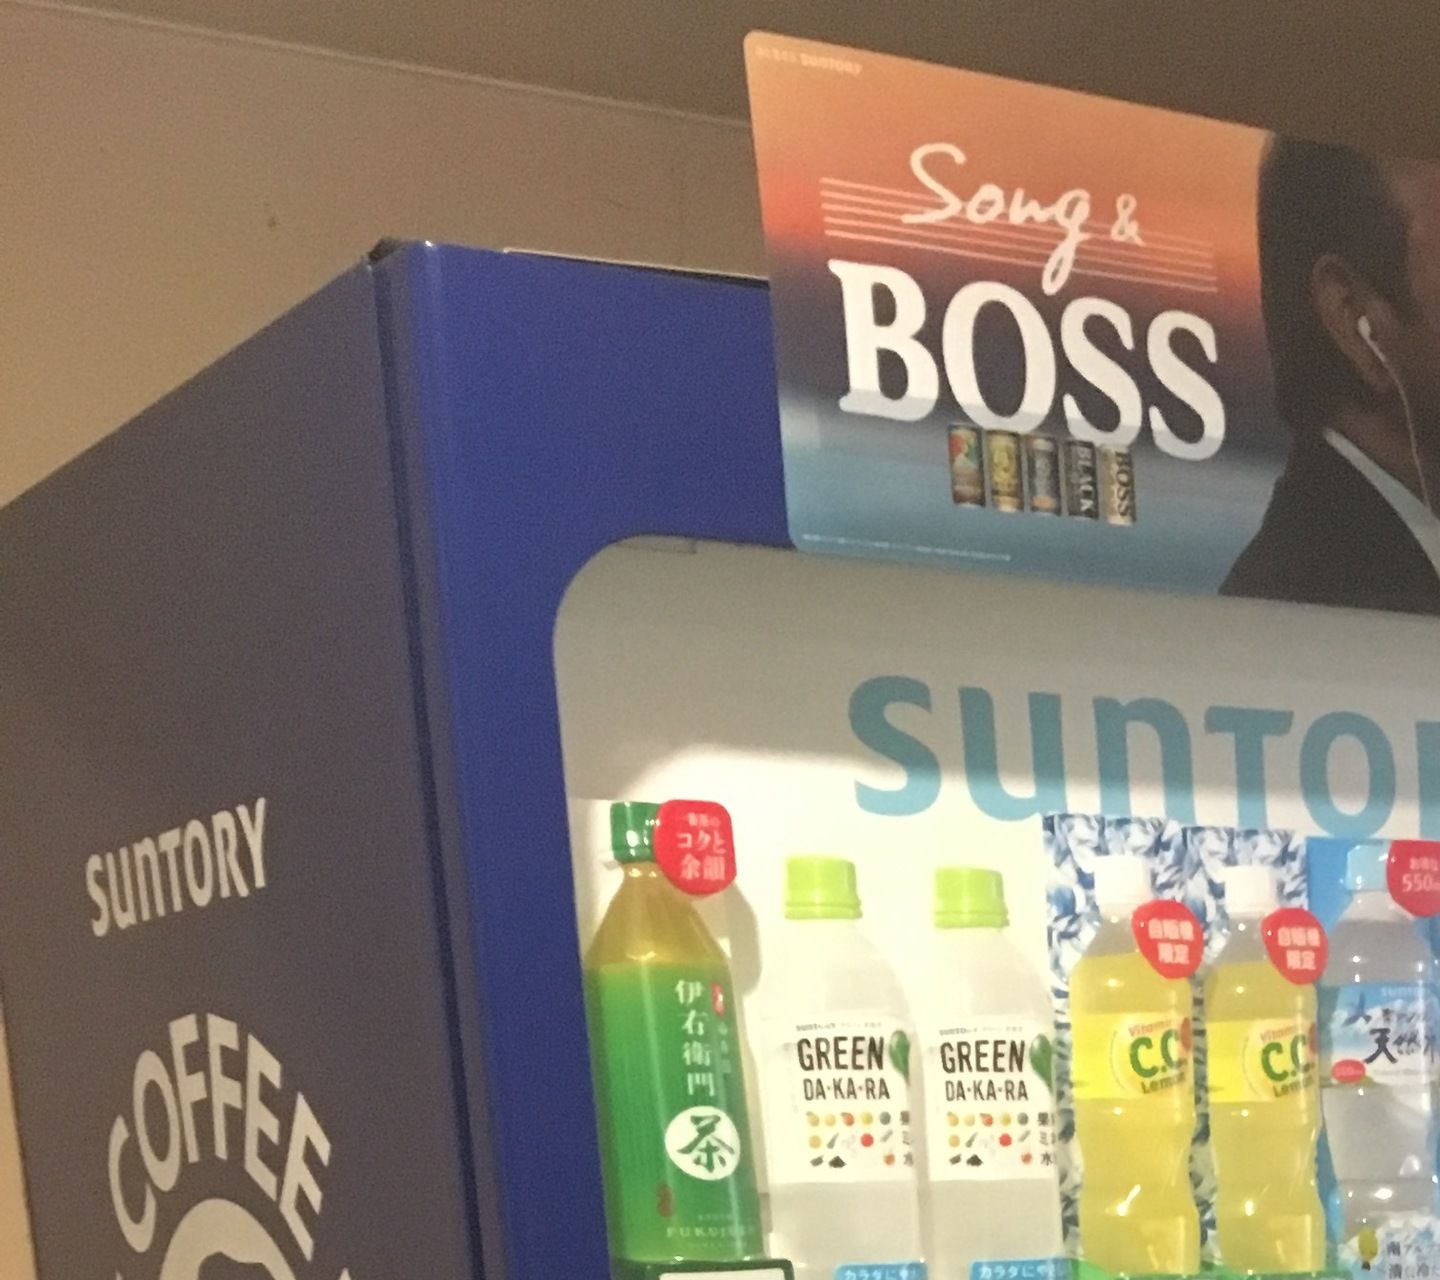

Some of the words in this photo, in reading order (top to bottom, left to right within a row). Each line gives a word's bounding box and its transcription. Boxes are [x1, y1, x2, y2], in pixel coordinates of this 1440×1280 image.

[902, 142, 1091, 296] Song
[1110, 193, 1146, 247] &
[828, 259, 1226, 461] BOSS
[85, 797, 266, 937] SUNTORY
[674, 979, 715, 1097] 伊右衛門
[797, 1036, 885, 1072] GREEN
[940, 1040, 1026, 1074] GREEN
[109, 1012, 331, 1262] COFFEE
[677, 1113, 734, 1172] 茶
